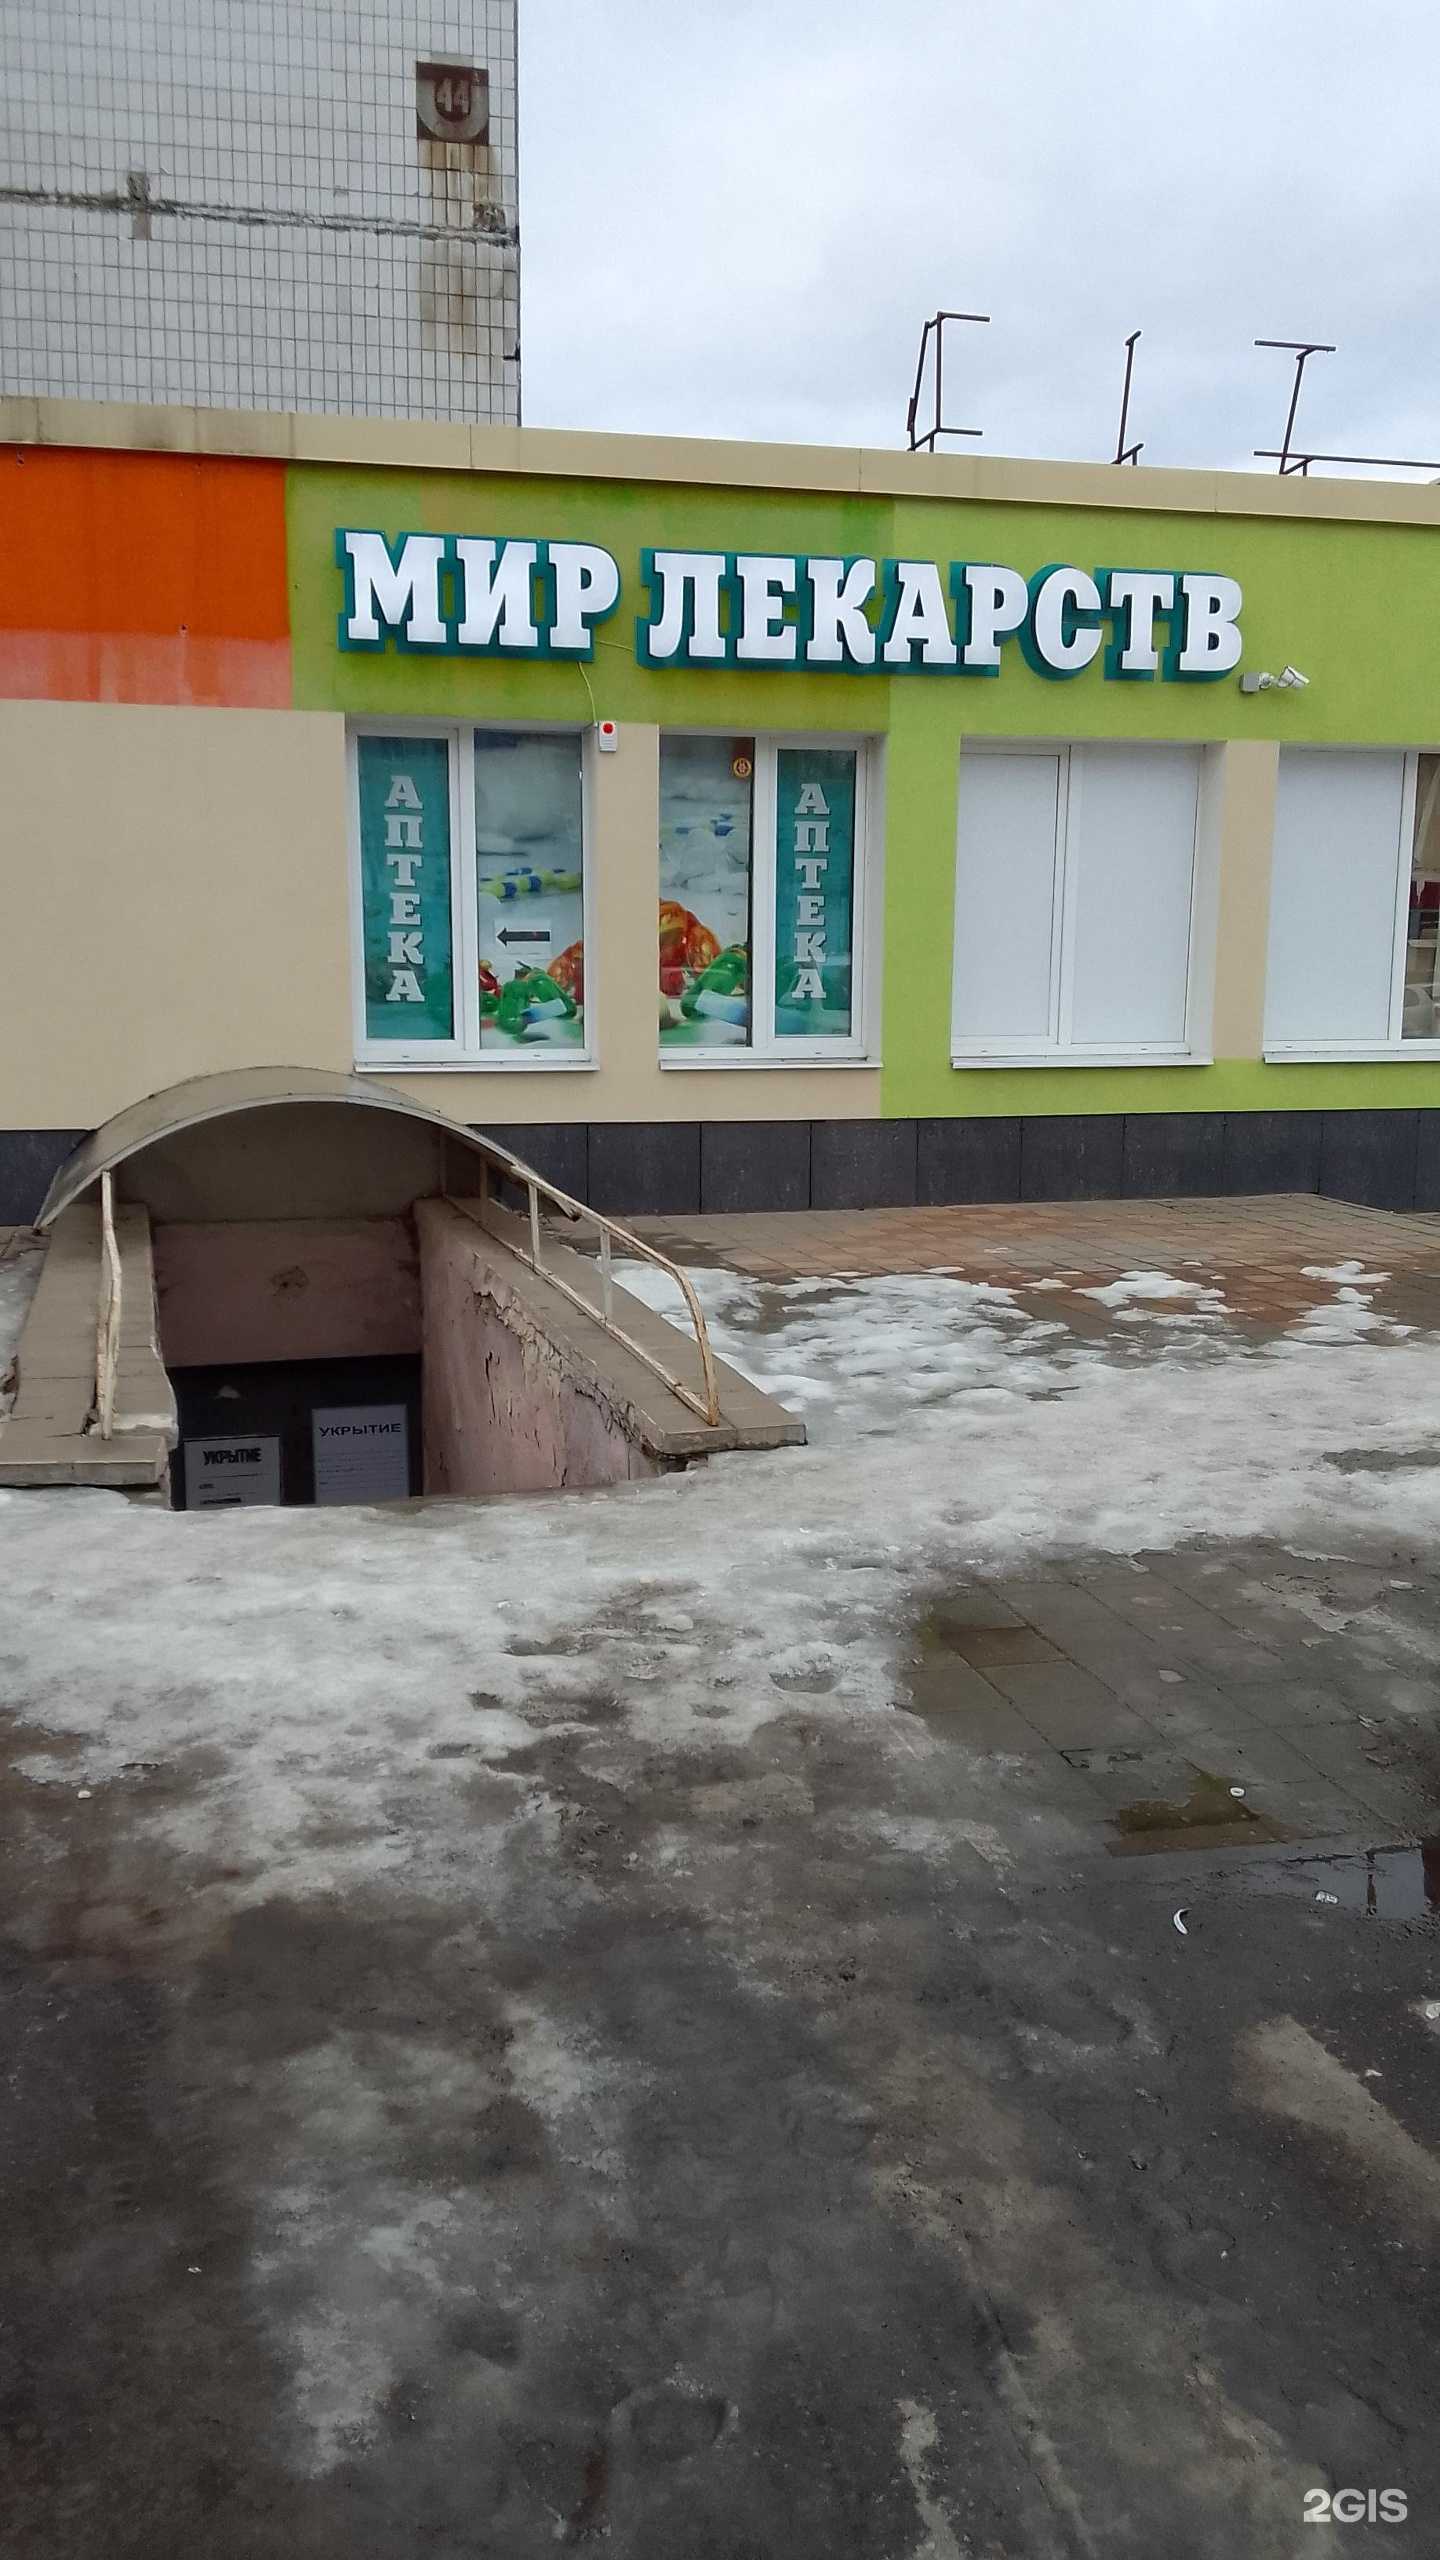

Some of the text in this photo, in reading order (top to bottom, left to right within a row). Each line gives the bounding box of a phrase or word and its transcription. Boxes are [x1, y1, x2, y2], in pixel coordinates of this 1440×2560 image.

[435, 78, 470, 113] 44
[343, 531, 1244, 672] МИР ЛЕКАРСТВ
[383, 774, 426, 1003] АПТЕКА
[791, 782, 831, 999] АПТЕКА
[202, 1447, 263, 1466] УКРЫТИЕ
[319, 1423, 402, 1437] УКРЫТИЕ
